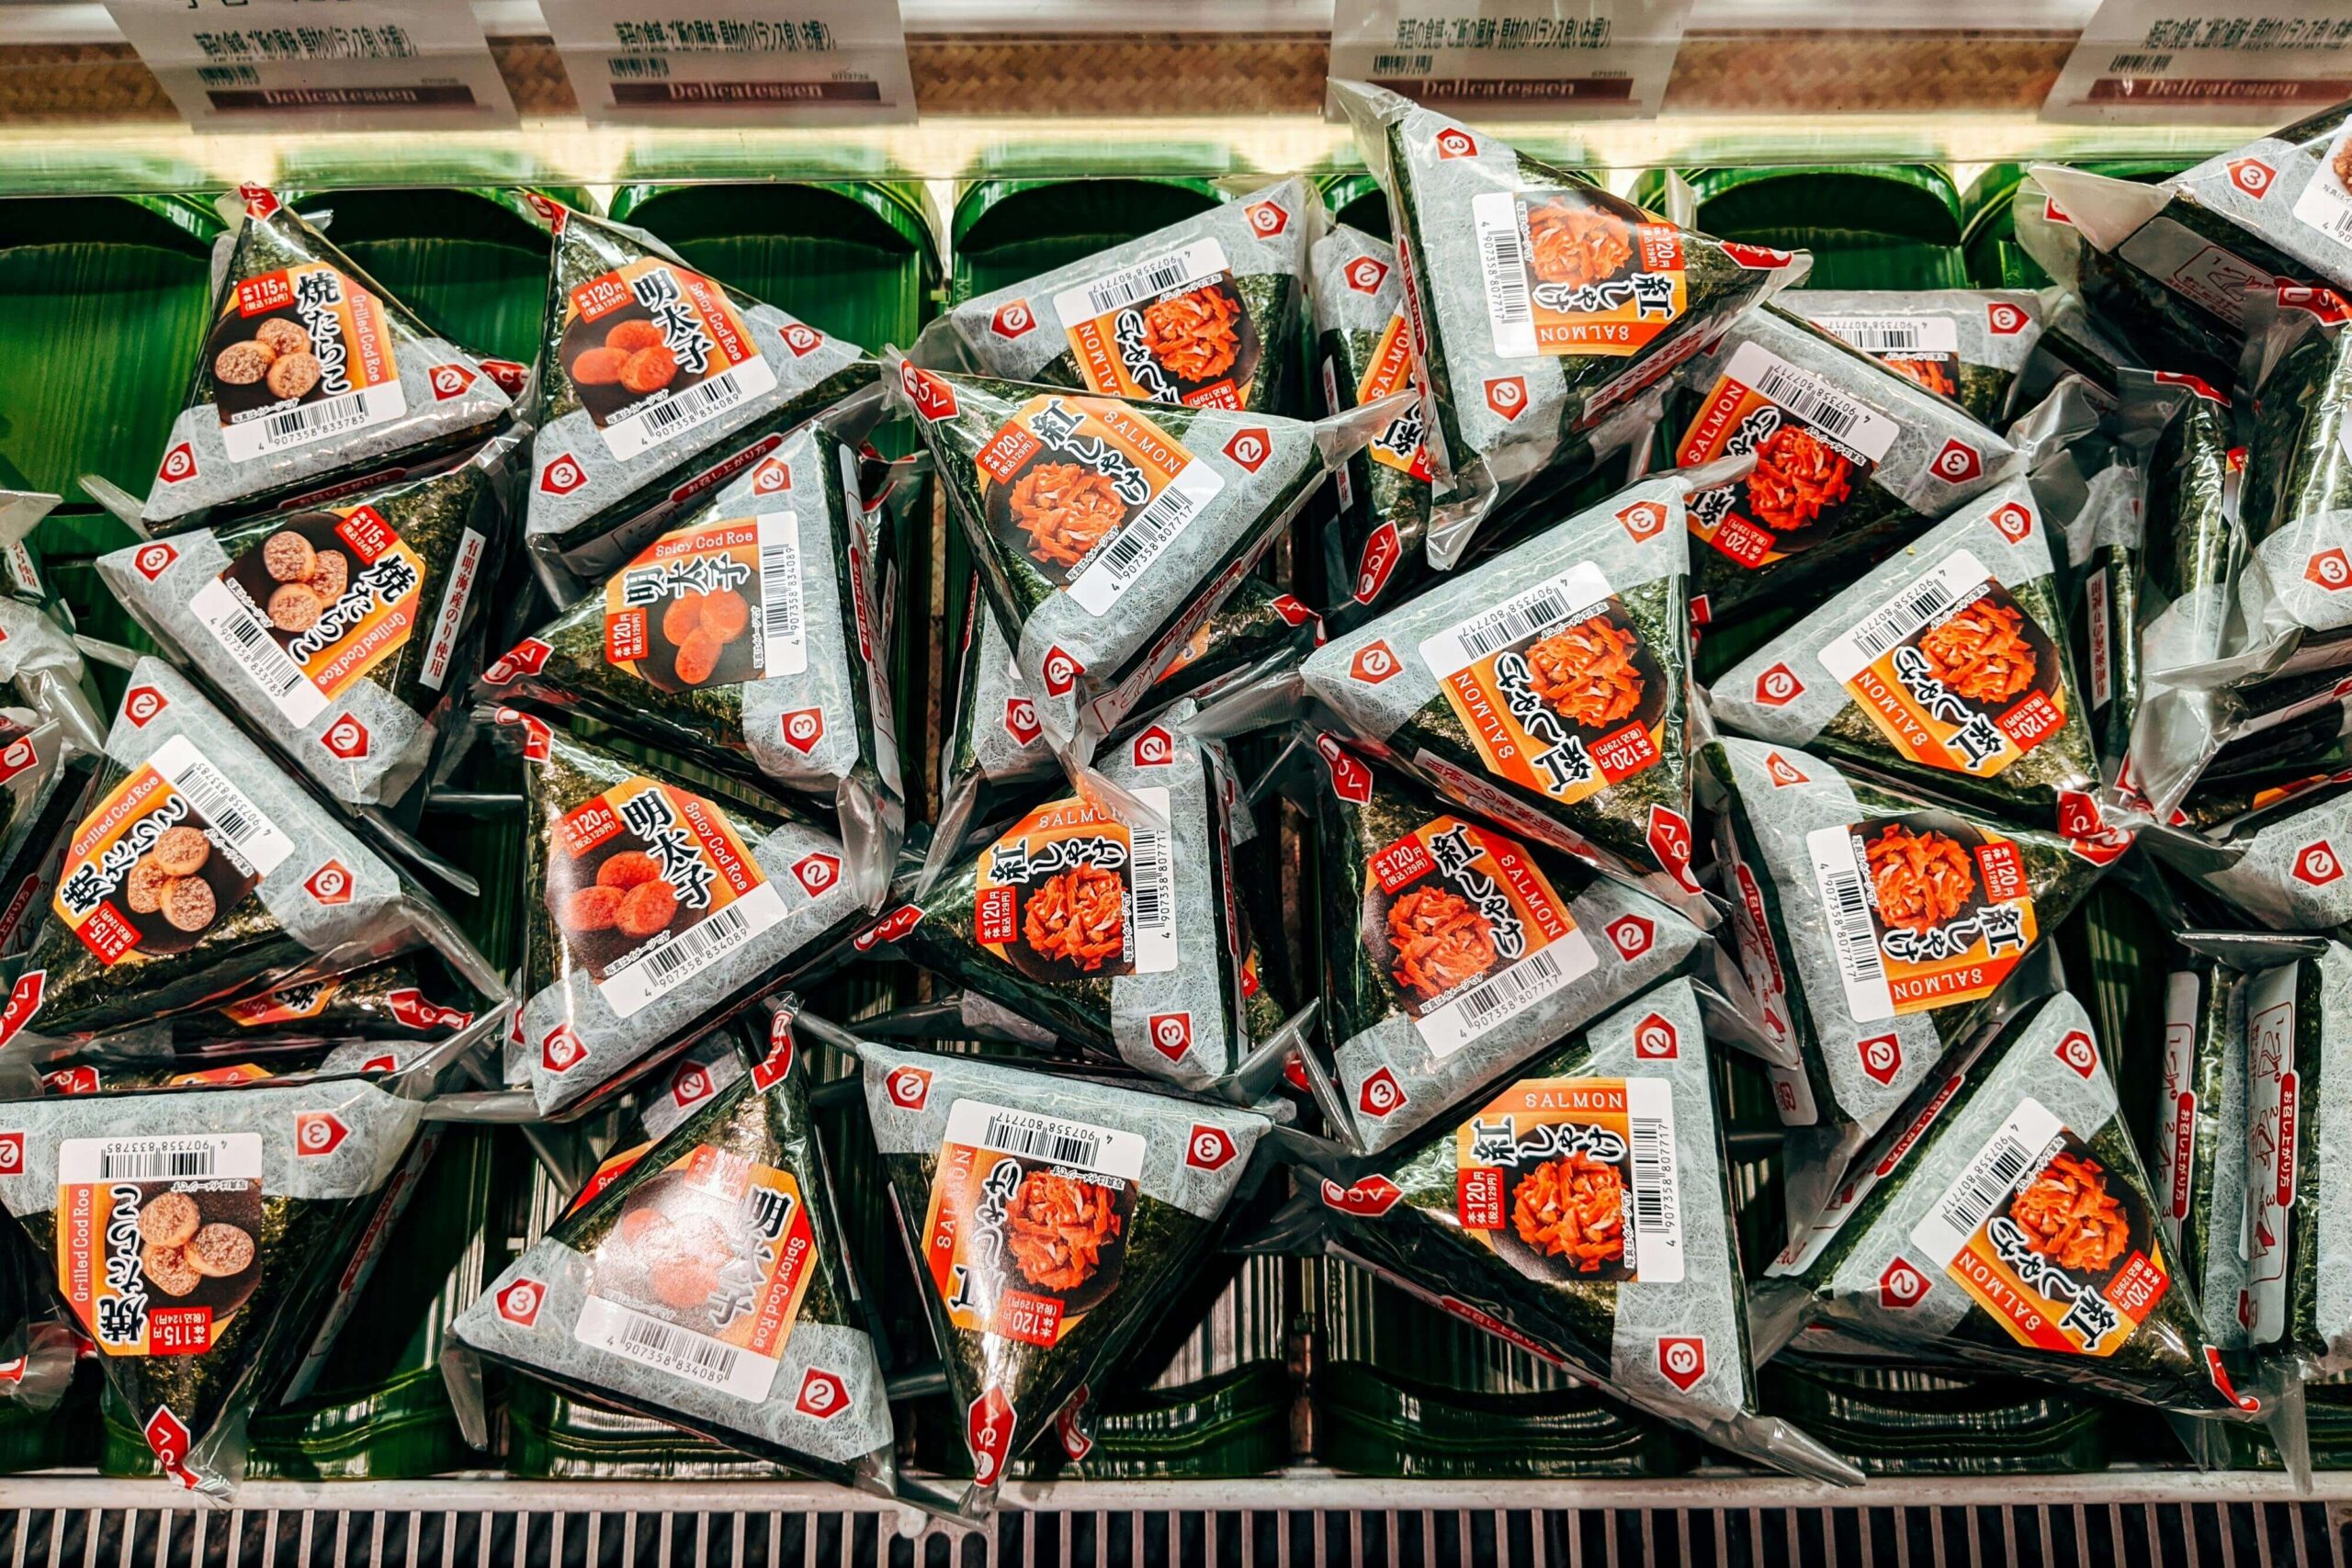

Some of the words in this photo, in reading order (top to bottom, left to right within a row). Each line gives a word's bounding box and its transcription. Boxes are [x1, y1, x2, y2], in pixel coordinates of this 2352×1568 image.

[264, 91, 417, 104] Delicatessen
[668, 84, 822, 100] Delicatessen
[1421, 80, 1575, 96] Delicatessen
[2147, 80, 2297, 96] Delicatessen
[350, 293, 372, 334] Grilled
[631, 266, 714, 373] 明太子
[687, 281, 713, 315] Spicy
[708, 310, 732, 339] Cod
[722, 335, 744, 362] Roe
[1535, 275, 1677, 315] 紅しゃけ
[299, 269, 350, 392] 焼たらこ
[360, 334, 379, 358] Cod
[1540, 322, 1631, 343] SALMON
[367, 359, 385, 382] Roe
[1101, 410, 1182, 473] SALMON
[1686, 383, 1743, 464] SALMON
[1030, 397, 1151, 505] 紅しゃけ
[655, 542, 692, 557] Spicy
[695, 534, 725, 548] Cod
[726, 530, 753, 545] Roe
[624, 552, 748, 604] 明太子
[289, 552, 417, 665] 焼たらこ
[361, 611, 405, 652] Grilled
[431, 539, 478, 678] 有明海産のり使用
[317, 664, 344, 691] Roe
[339, 644, 367, 671] Cod
[1453, 672, 1517, 760] SALMON
[1496, 652, 1589, 794] 紅しゃけ
[1857, 672, 1930, 747] SALMON
[1893, 646, 2003, 769] 紅しゃけ
[73, 814, 116, 856] Grilled
[110, 793, 138, 820] Cod
[133, 773, 160, 799] Roe
[59, 795, 187, 915] 焼たらこ
[619, 787, 716, 908] 明太子
[683, 801, 712, 840] Spicy
[707, 834, 735, 867] Cod
[725, 861, 750, 893] Roe
[989, 838, 1125, 881] 紅しゃけ
[1432, 822, 1523, 958] 紅しゃけ
[1498, 852, 1563, 937] SALMON
[1884, 909, 2028, 963] 紅しゃけ
[1894, 966, 1985, 1000] SALMON
[1525, 1092, 1622, 1108] SALMON
[1472, 1115, 1624, 1165] 紅しゃけ
[2178, 1109, 2190, 1201] お召し上がり方
[2280, 1091, 2293, 1188] お召し上がり方
[74, 1189, 88, 1215] Roe
[74, 1219, 88, 1247] Cod
[782, 1237, 806, 1281] Spicy
[74, 1250, 88, 1301] Grilled
[98, 1188, 147, 1342] 焼たらこ
[1957, 1252, 2044, 1331] SALMON
[1986, 1217, 2117, 1349] 紅しゃけ
[765, 1284, 788, 1319] Cod
[753, 1318, 778, 1348] Roe
